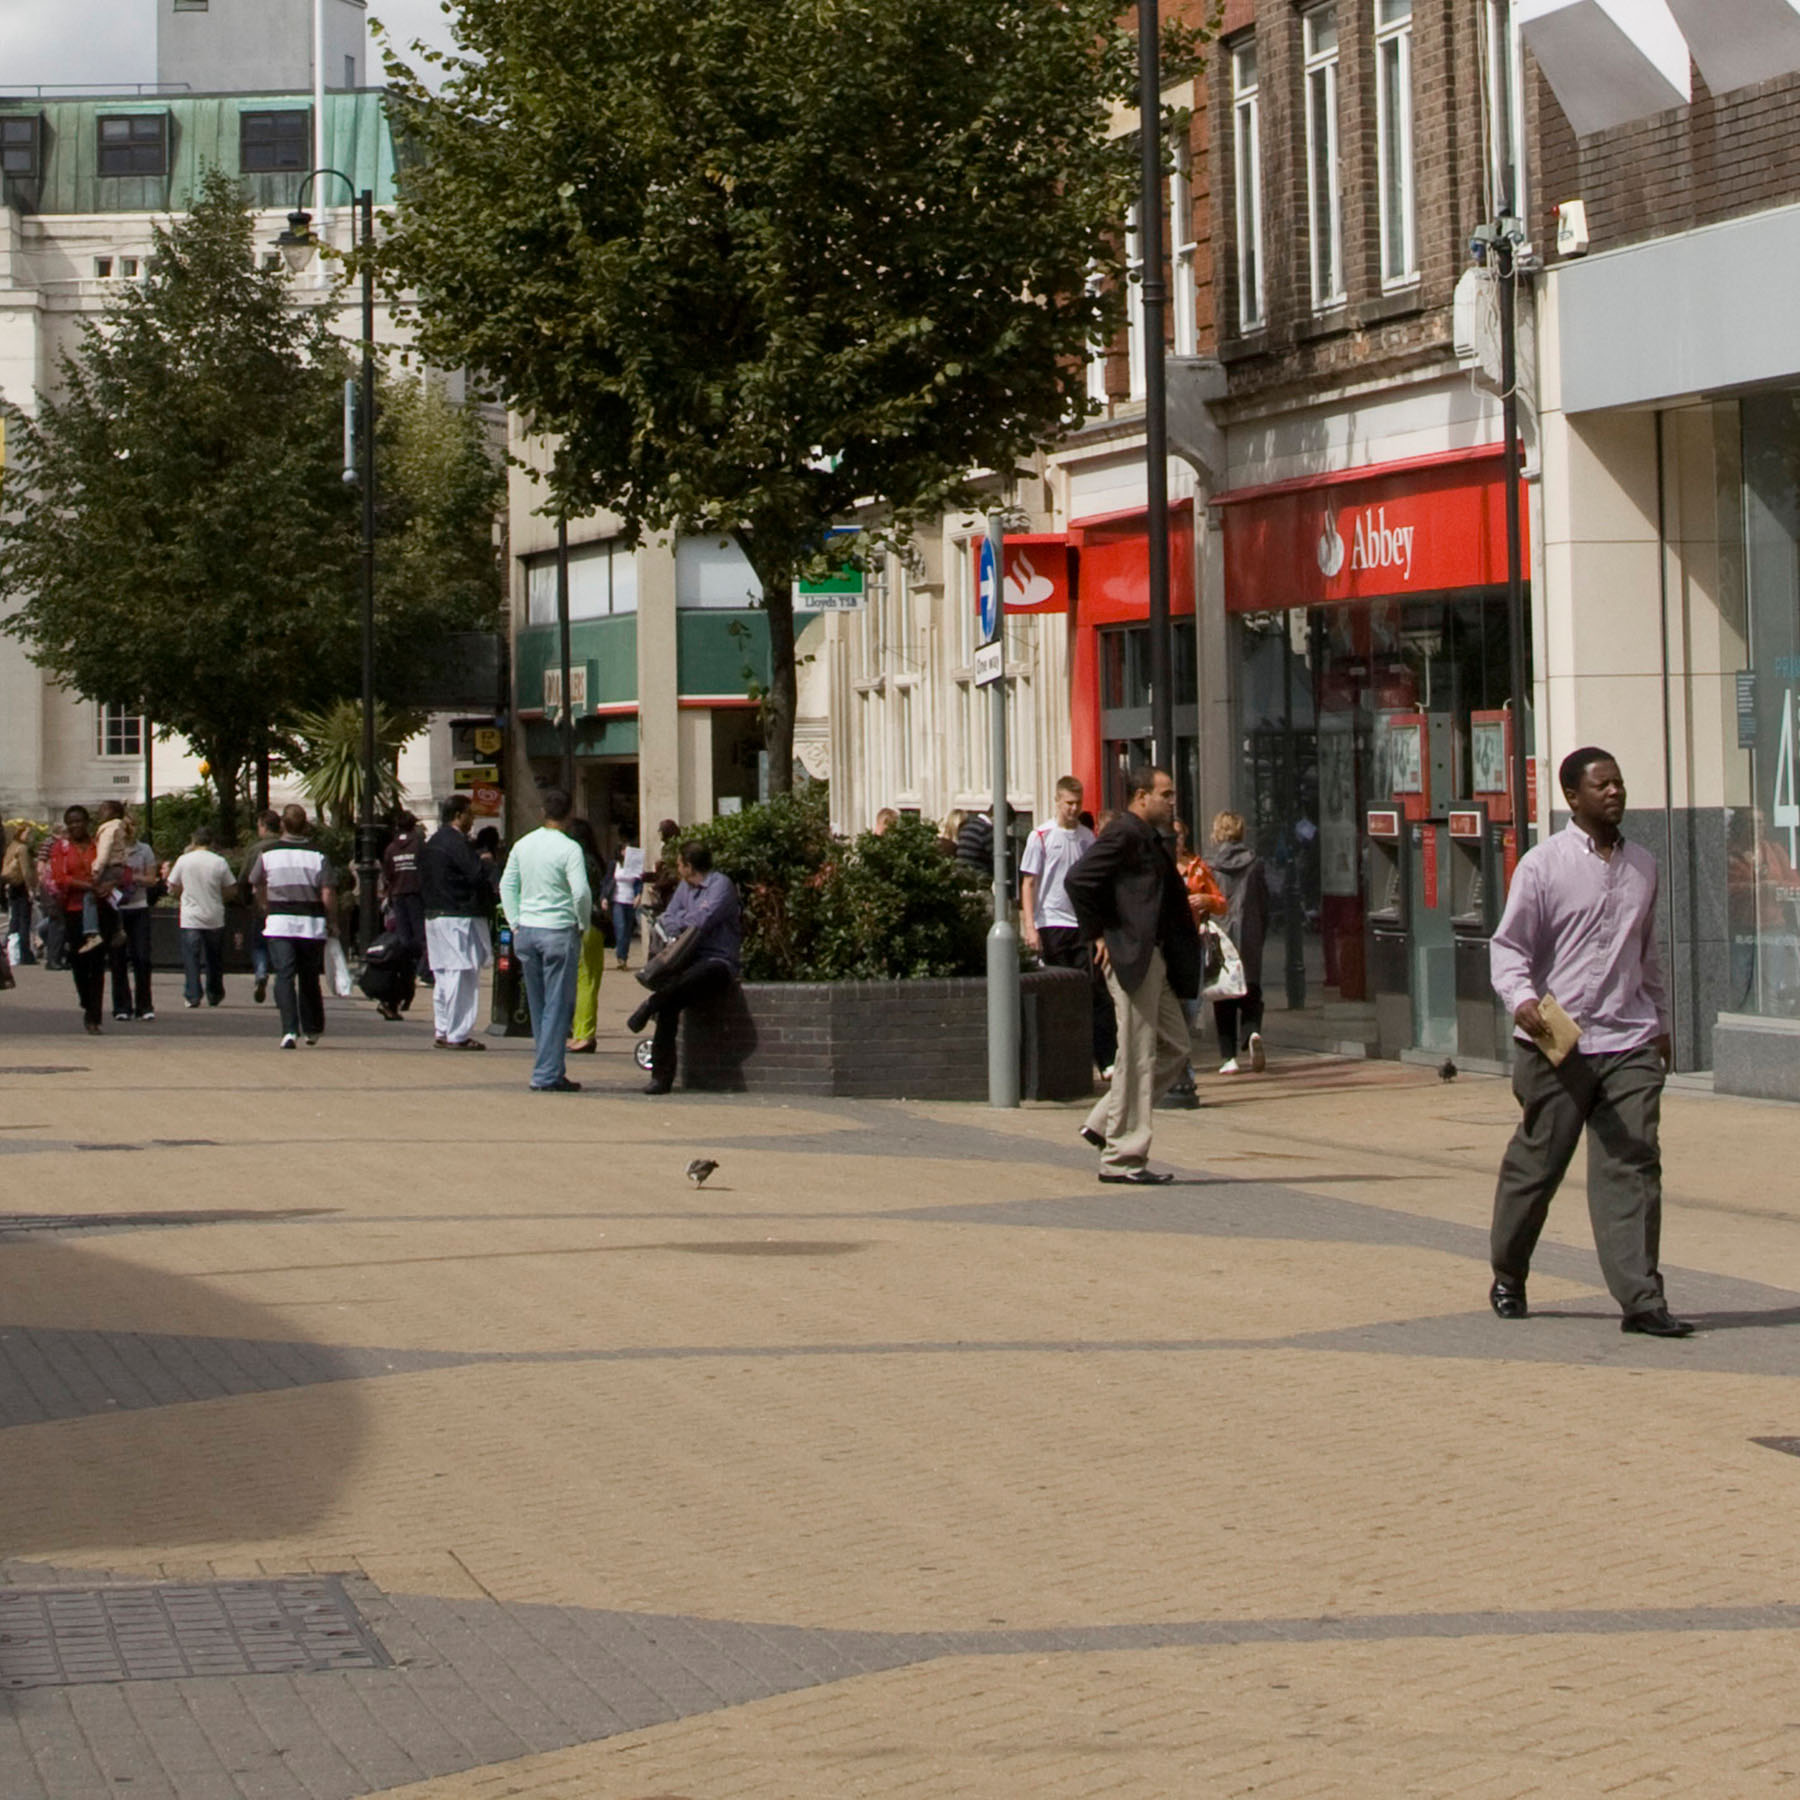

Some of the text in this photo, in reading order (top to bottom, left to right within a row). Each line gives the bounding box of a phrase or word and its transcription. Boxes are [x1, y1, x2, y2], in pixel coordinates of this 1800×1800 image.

[1350, 507, 1415, 580] Abbey
[805, 596, 857, 610] Lloyds TSB
